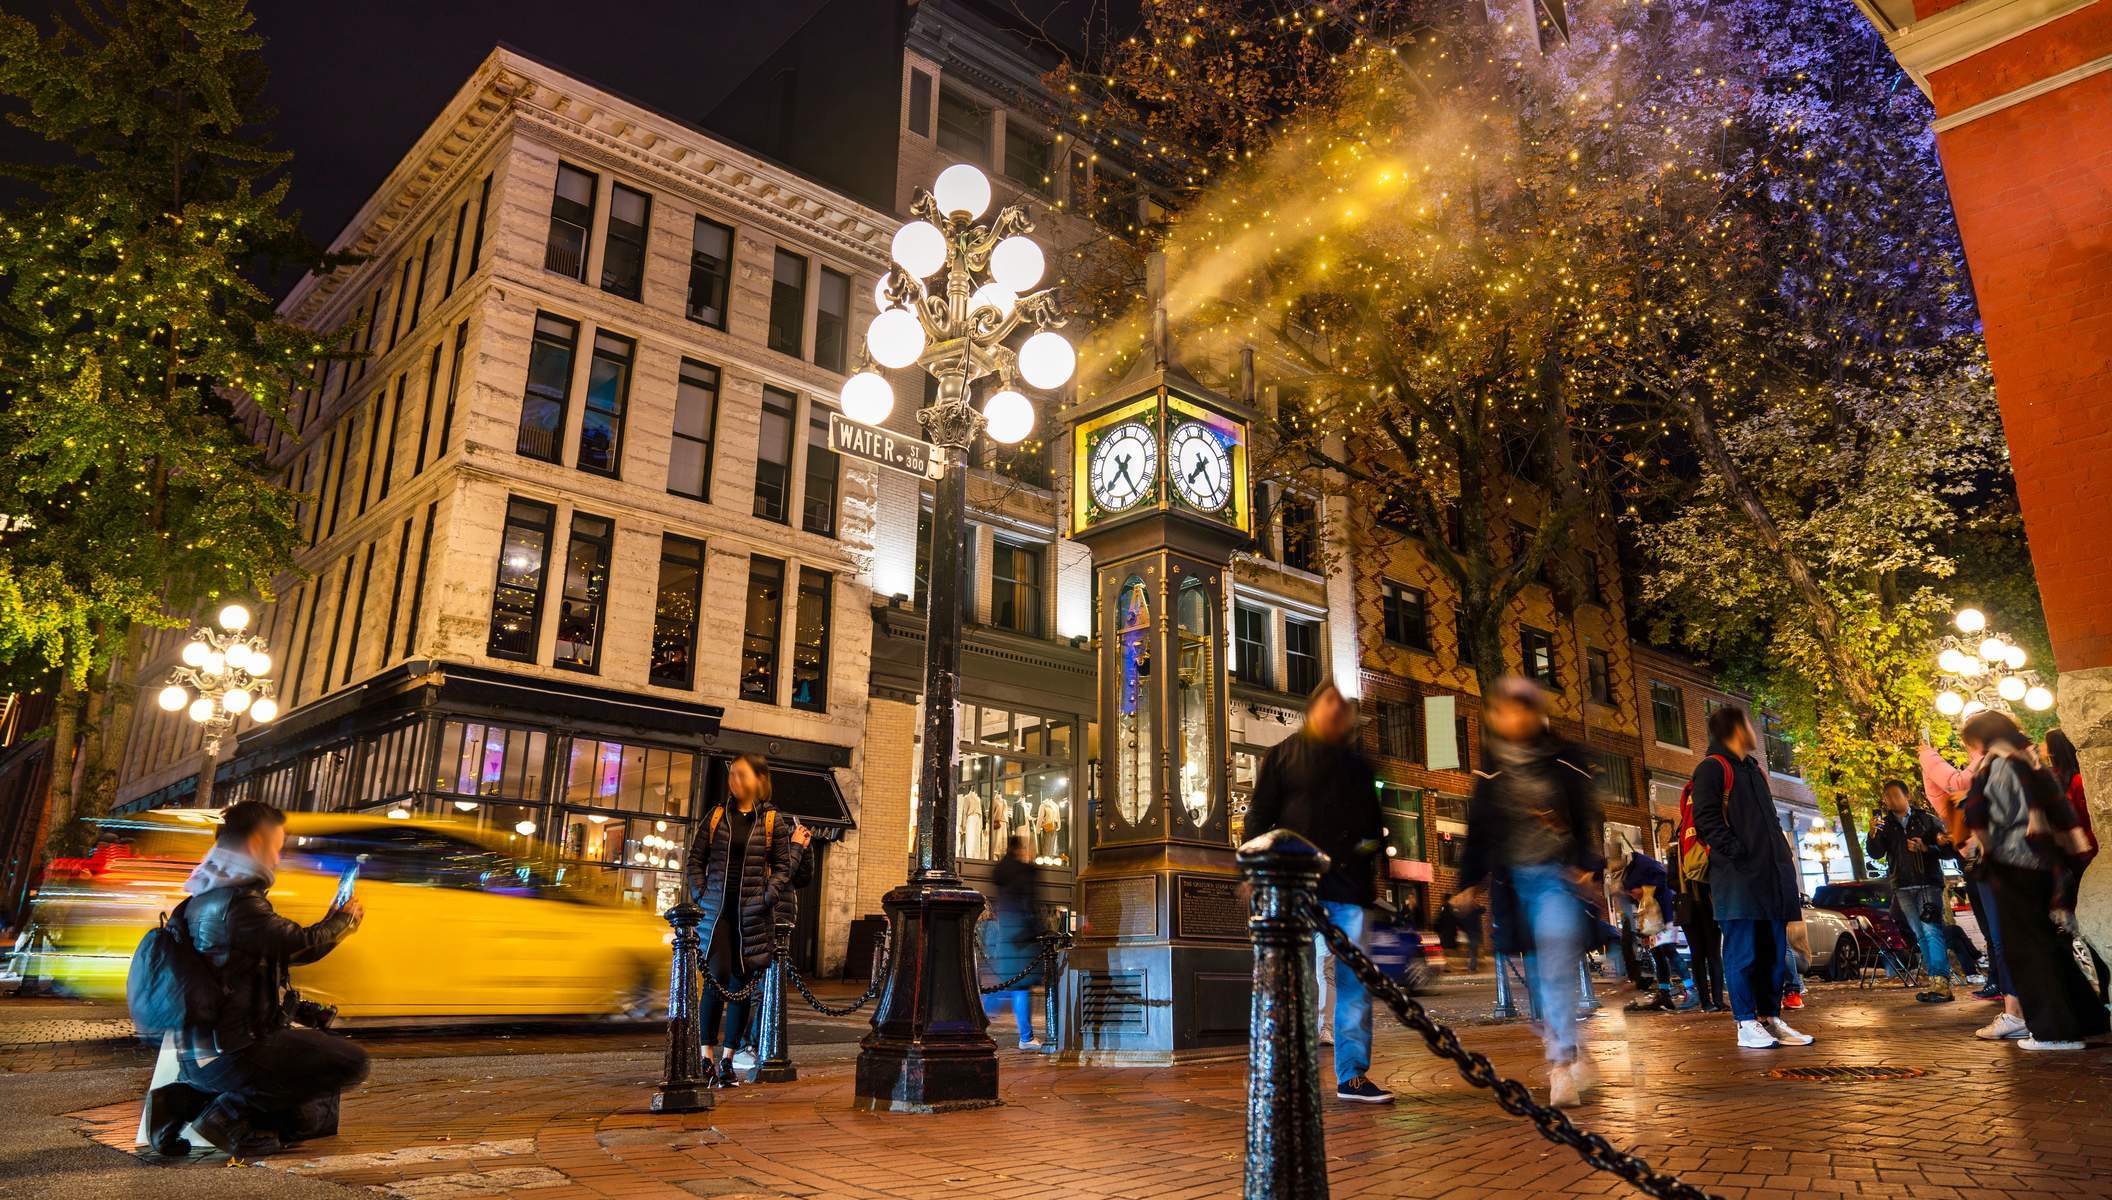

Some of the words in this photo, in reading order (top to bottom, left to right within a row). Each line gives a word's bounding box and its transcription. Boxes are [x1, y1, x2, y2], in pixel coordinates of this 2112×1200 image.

[840, 423, 894, 462] WATER
[910, 446, 920, 457] ST
[906, 457, 924, 471] 300
